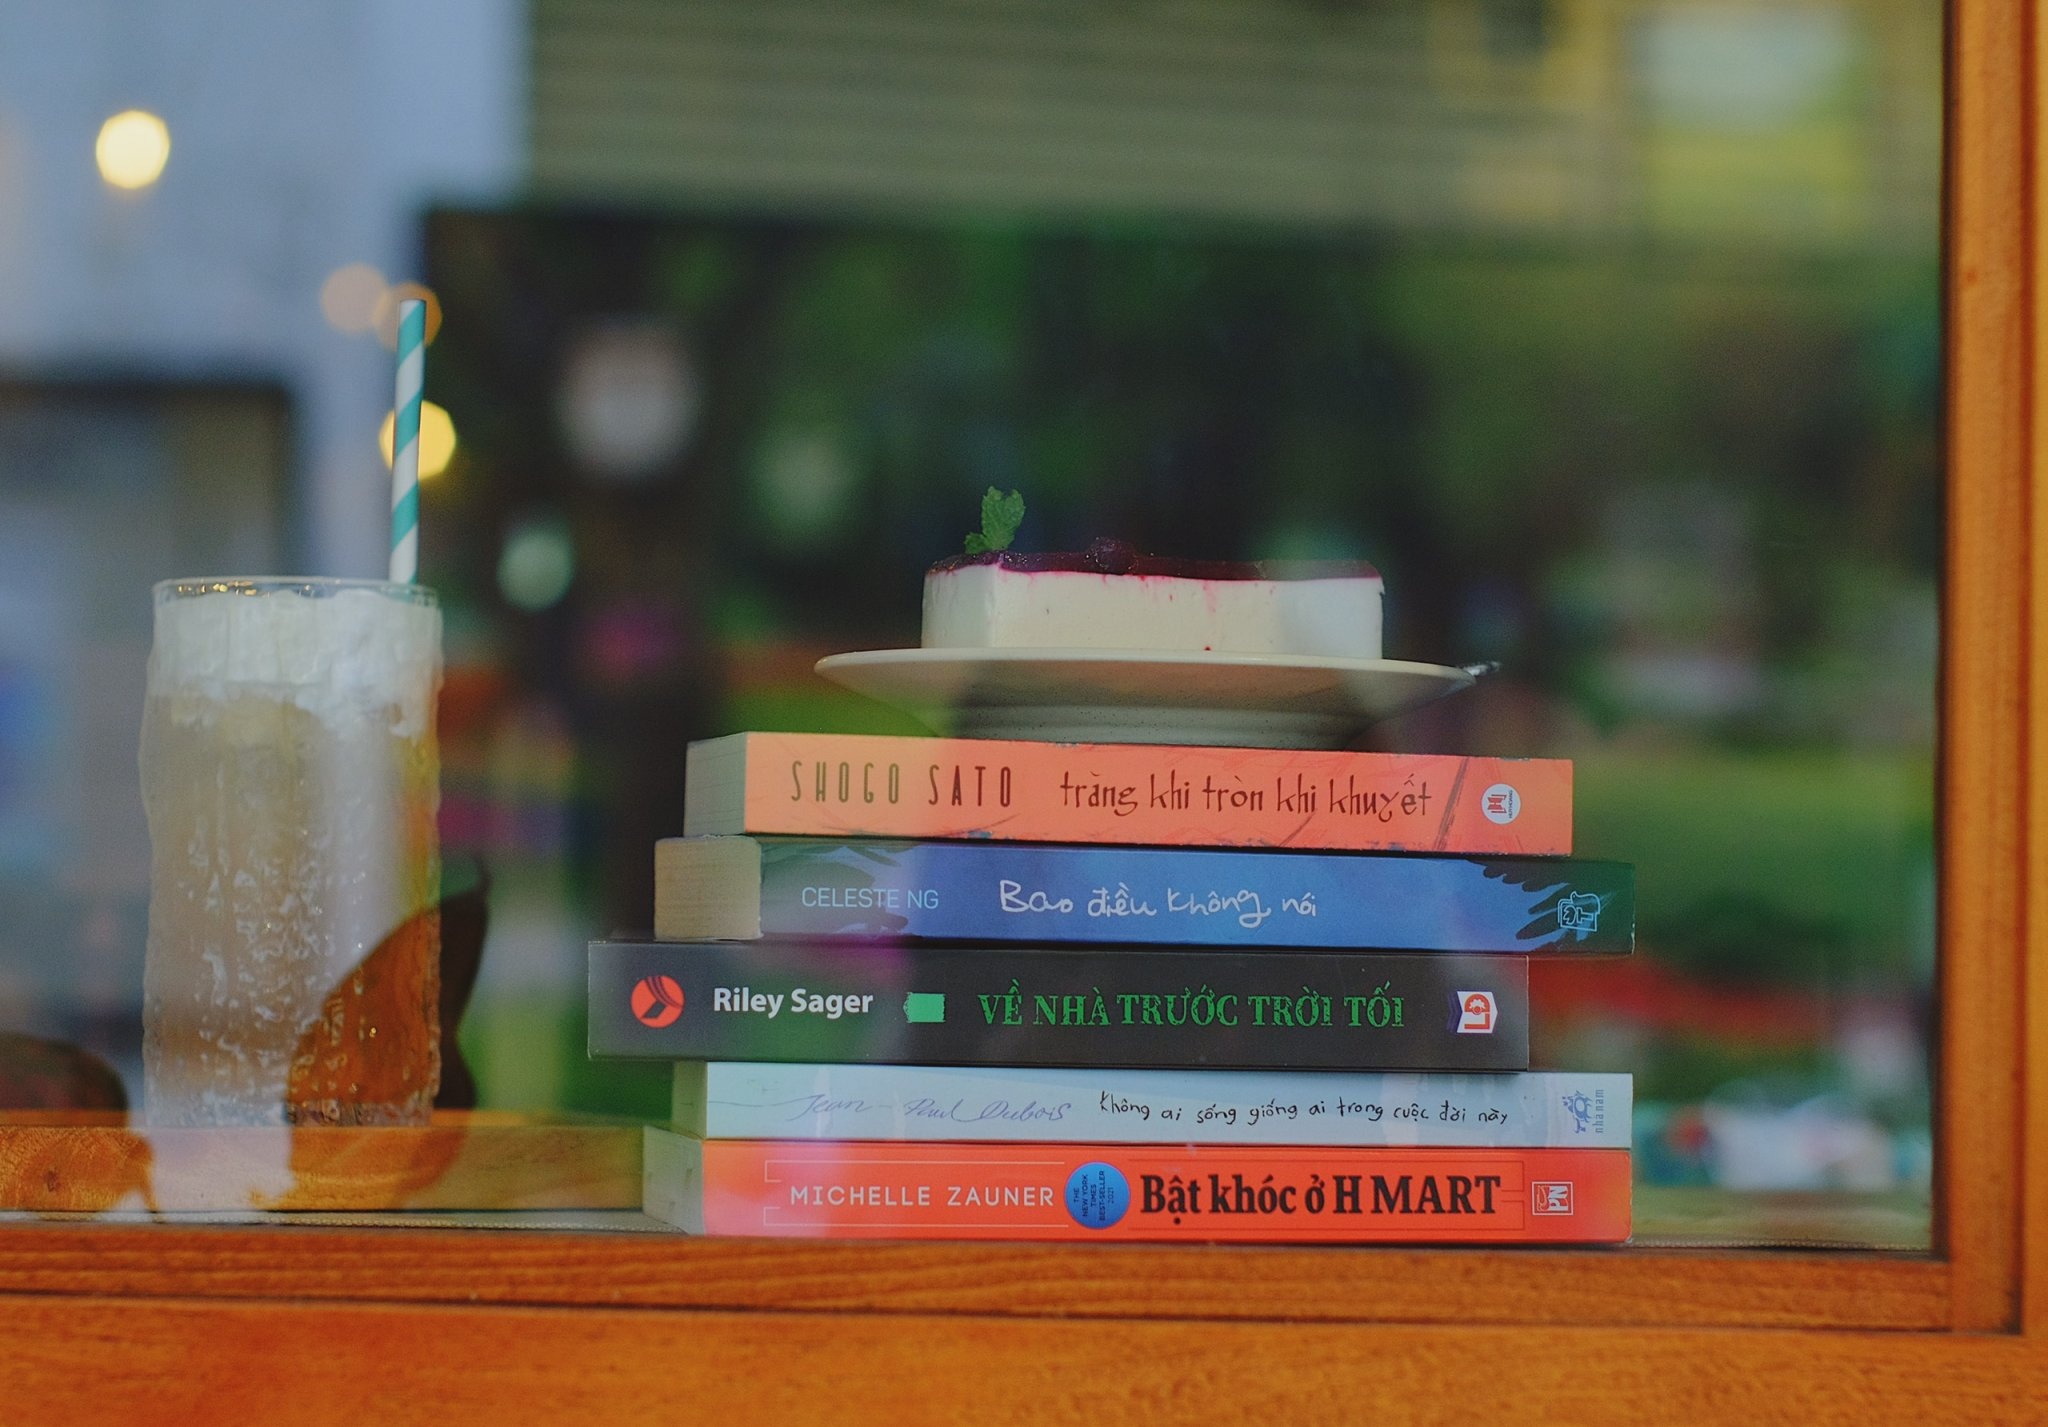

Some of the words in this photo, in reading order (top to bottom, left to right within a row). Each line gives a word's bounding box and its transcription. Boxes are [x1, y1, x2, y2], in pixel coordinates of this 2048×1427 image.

[792, 760, 900, 804] SHOGO
[929, 764, 1011, 808] SATO
[1150, 769, 1190, 810] khi
[1201, 775, 1263, 812] tròn
[1276, 773, 1316, 813] khi
[1329, 772, 1432, 822] khuyết
[801, 886, 900, 909] CELESTE
[906, 889, 940, 911] NG
[1000, 879, 1074, 913] Bao
[1087, 882, 1158, 918] điều
[1282, 892, 1317, 917] nói
[713, 987, 784, 1020] Riley
[791, 988, 874, 1020] Sager
[977, 979, 1024, 1026] VỀ
[1032, 986, 1111, 1027] NHÀ
[1117, 984, 1240, 1027] TRƯỚC
[1247, 985, 1333, 1027] TRỜI
[1343, 979, 1406, 1028] TỐI
[1161, 1106, 1182, 1122] ai
[1197, 1102, 1238, 1125] sống
[1247, 1098, 1298, 1126] giống
[1308, 1101, 1326, 1115] ai
[1336, 1096, 1384, 1123] trong
[1394, 1103, 1429, 1123] cuộc
[1439, 1099, 1467, 1123] đời
[1477, 1106, 1509, 1126] này
[790, 1185, 931, 1207] MICHELLE
[946, 1186, 1055, 1207] ZAUNER
[1098, 1170, 1106, 1221] BEST-SELLER
[1140, 1174, 1201, 1226] Bật
[1207, 1174, 1297, 1214] khóc
[1304, 1174, 1326, 1214] ở
[1332, 1175, 1363, 1213] H
[1370, 1175, 1501, 1214] MART
